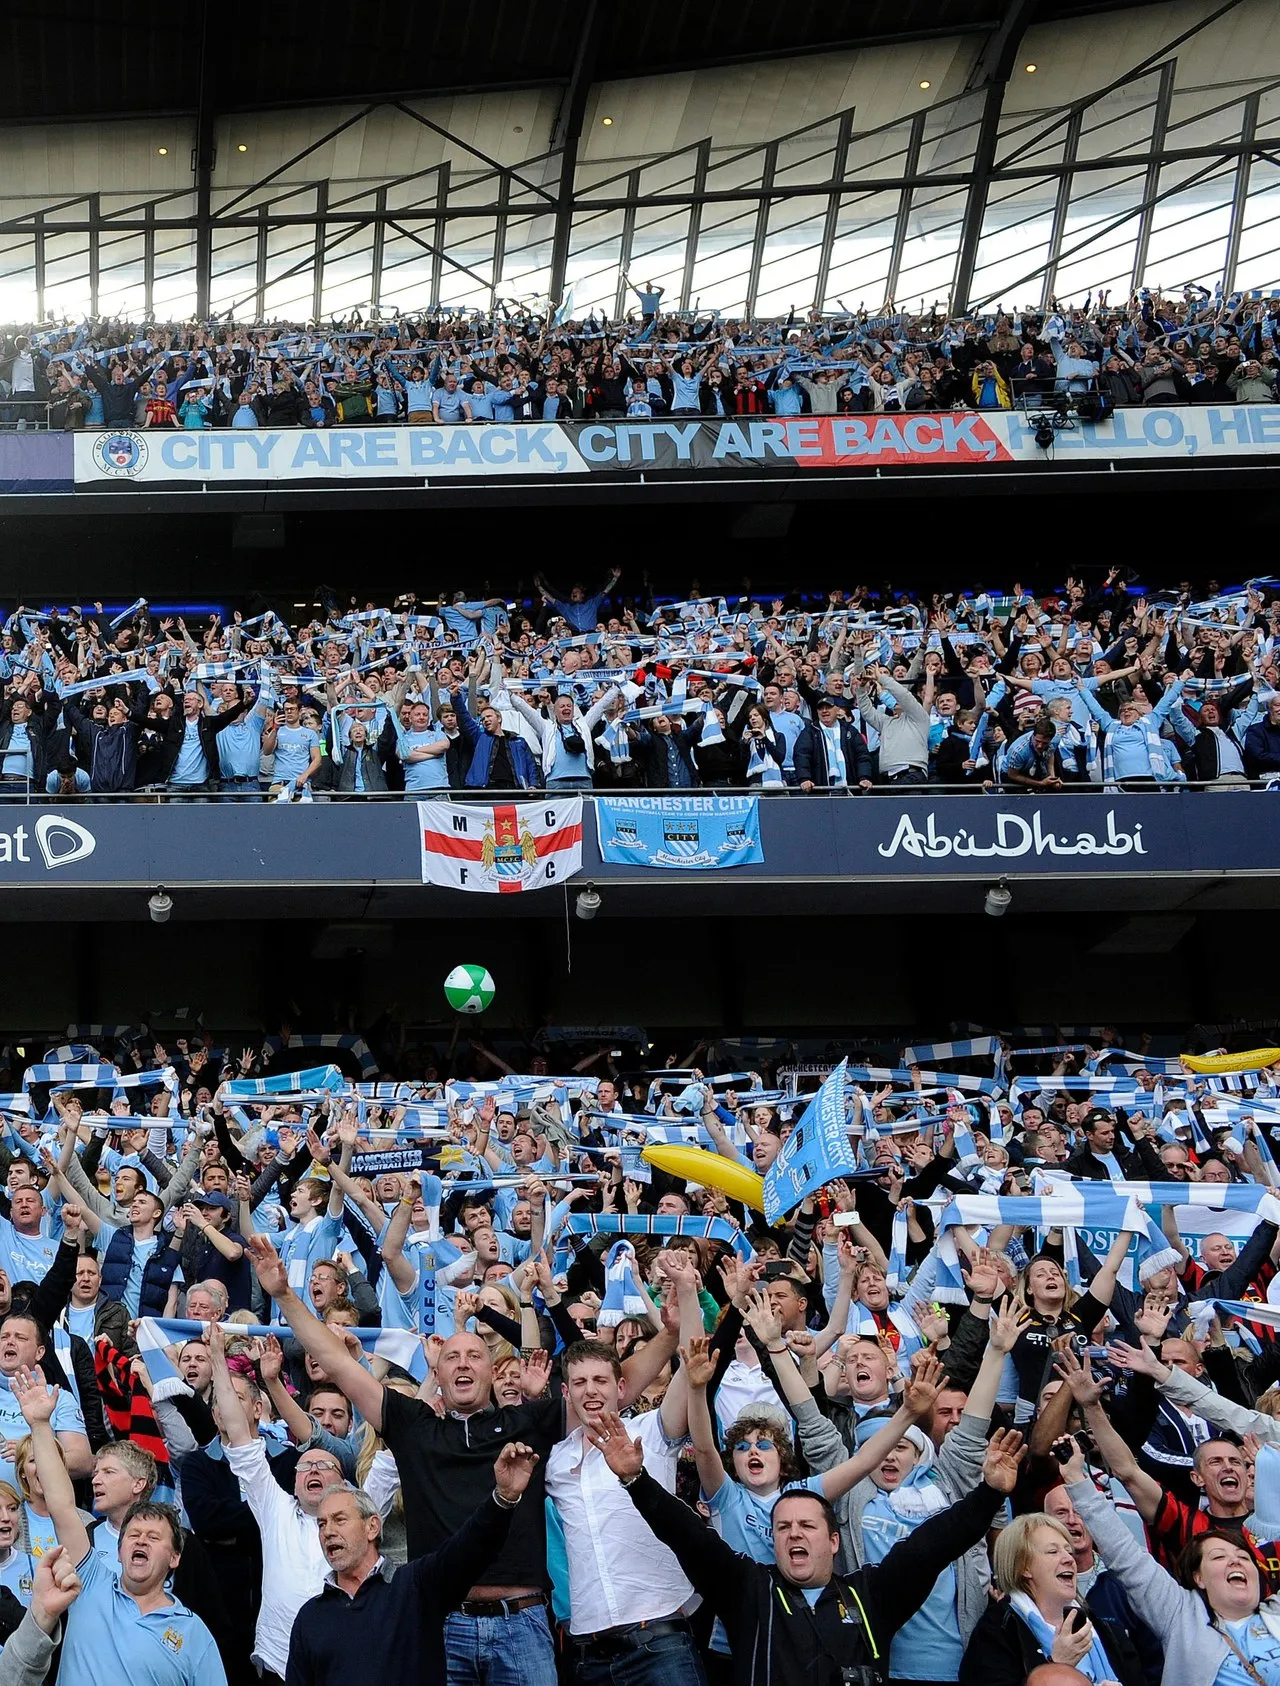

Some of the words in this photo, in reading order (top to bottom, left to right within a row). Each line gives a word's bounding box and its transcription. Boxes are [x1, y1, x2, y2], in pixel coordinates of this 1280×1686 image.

[161, 432, 282, 471] CITY
[290, 430, 399, 468] ARE
[409, 425, 569, 472] BACK,
[578, 422, 702, 463] CITY
[712, 420, 823, 459] ARE
[832, 415, 998, 461] BACK,
[603, 796, 715, 812] MANCHESTER
[718, 796, 756, 811] CITY
[452, 815, 468, 832] M
[545, 810, 556, 827] C
[667, 833, 697, 841] CITY
[877, 812, 994, 858] Abu
[992, 809, 1149, 857] Dhabi
[660, 853, 694, 864] Manchester
[694, 855, 706, 863] City
[459, 867, 469, 885] F
[545, 861, 556, 879] C
[827, 1142, 846, 1169] CITY
[350, 1165, 365, 1173] ITY
[365, 1161, 403, 1171] FOOTBALL
[403, 1160, 423, 1168] CLUB
[423, 1279, 436, 1335] CFC
